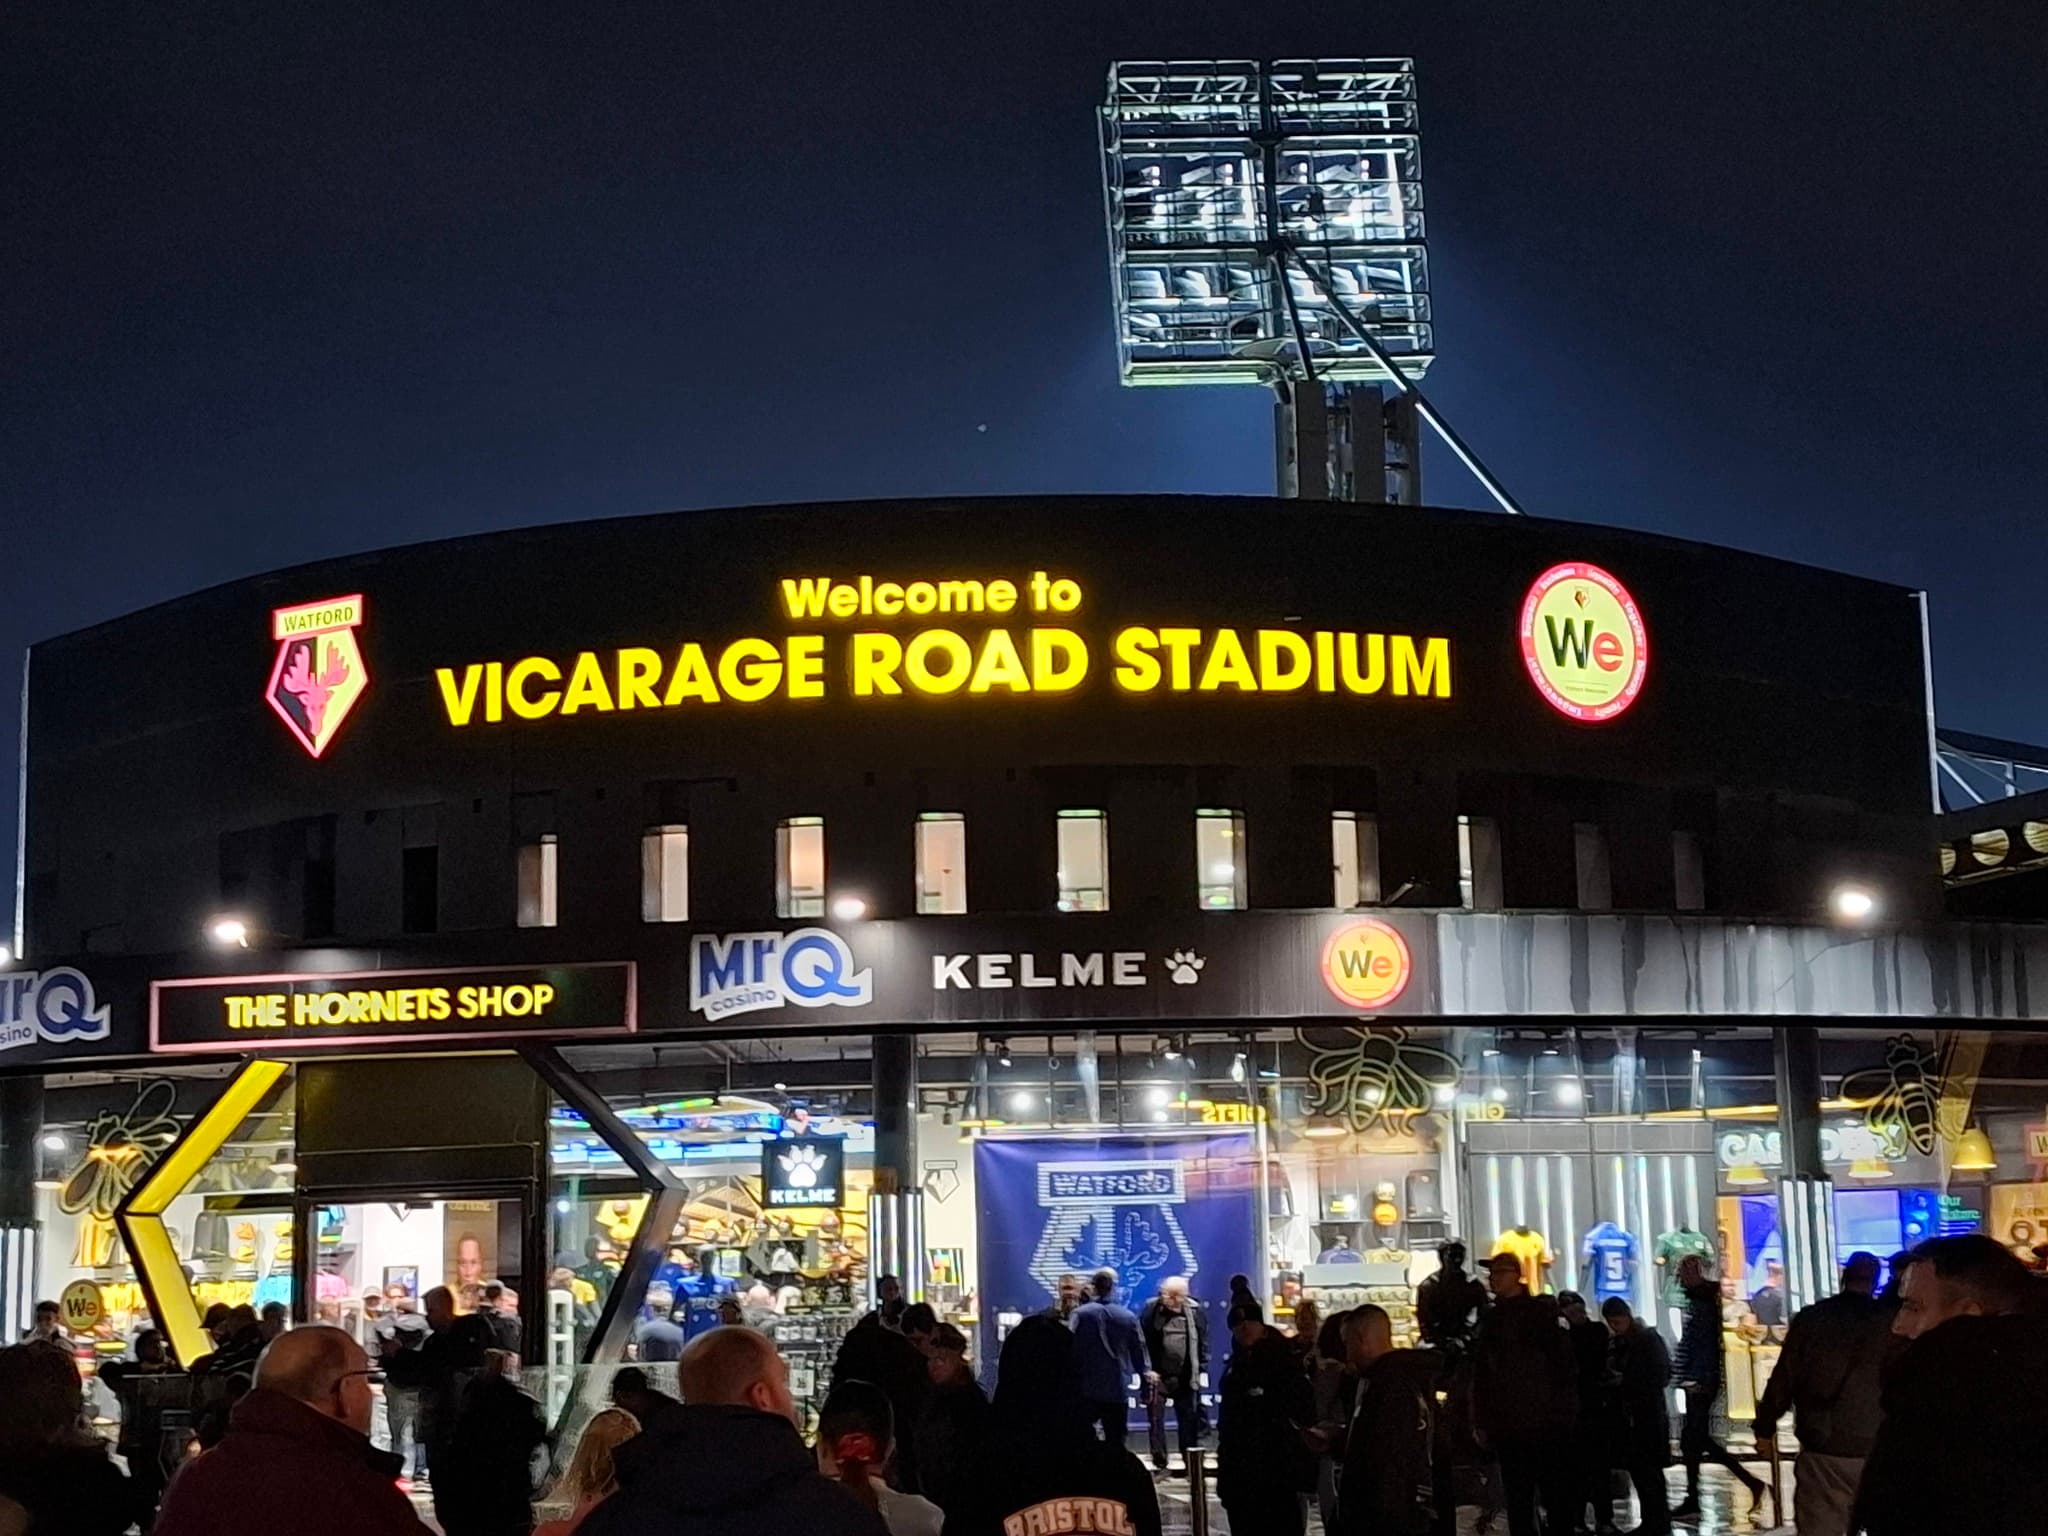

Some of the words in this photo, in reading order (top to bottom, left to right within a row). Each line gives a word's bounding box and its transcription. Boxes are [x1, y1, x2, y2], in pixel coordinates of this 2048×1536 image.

[781, 575, 1018, 620] Welcome
[1031, 571, 1082, 612] to
[284, 607, 353, 632] WATFORD
[1544, 615, 1624, 672] We
[435, 635, 825, 727] VICARAGE
[853, 629, 1089, 696] ROAD
[1114, 627, 1452, 698] STADIUM
[700, 935, 861, 999] MrQ
[933, 952, 1146, 989] KELME
[1338, 949, 1393, 979] We
[0, 973, 104, 1035] rQ
[225, 995, 287, 1028] THE
[294, 988, 450, 1025] HORNETS
[457, 984, 554, 1019] SHOP
[710, 987, 776, 1013] casino
[0, 1026, 32, 1044] sino
[770, 1188, 836, 1204] KELME
[1052, 1171, 1171, 1195] WATFORD
[1604, 1251, 1623, 1280] 5
[66, 1298, 97, 1318] We
[1005, 1500, 1133, 1536] BRISTOL
